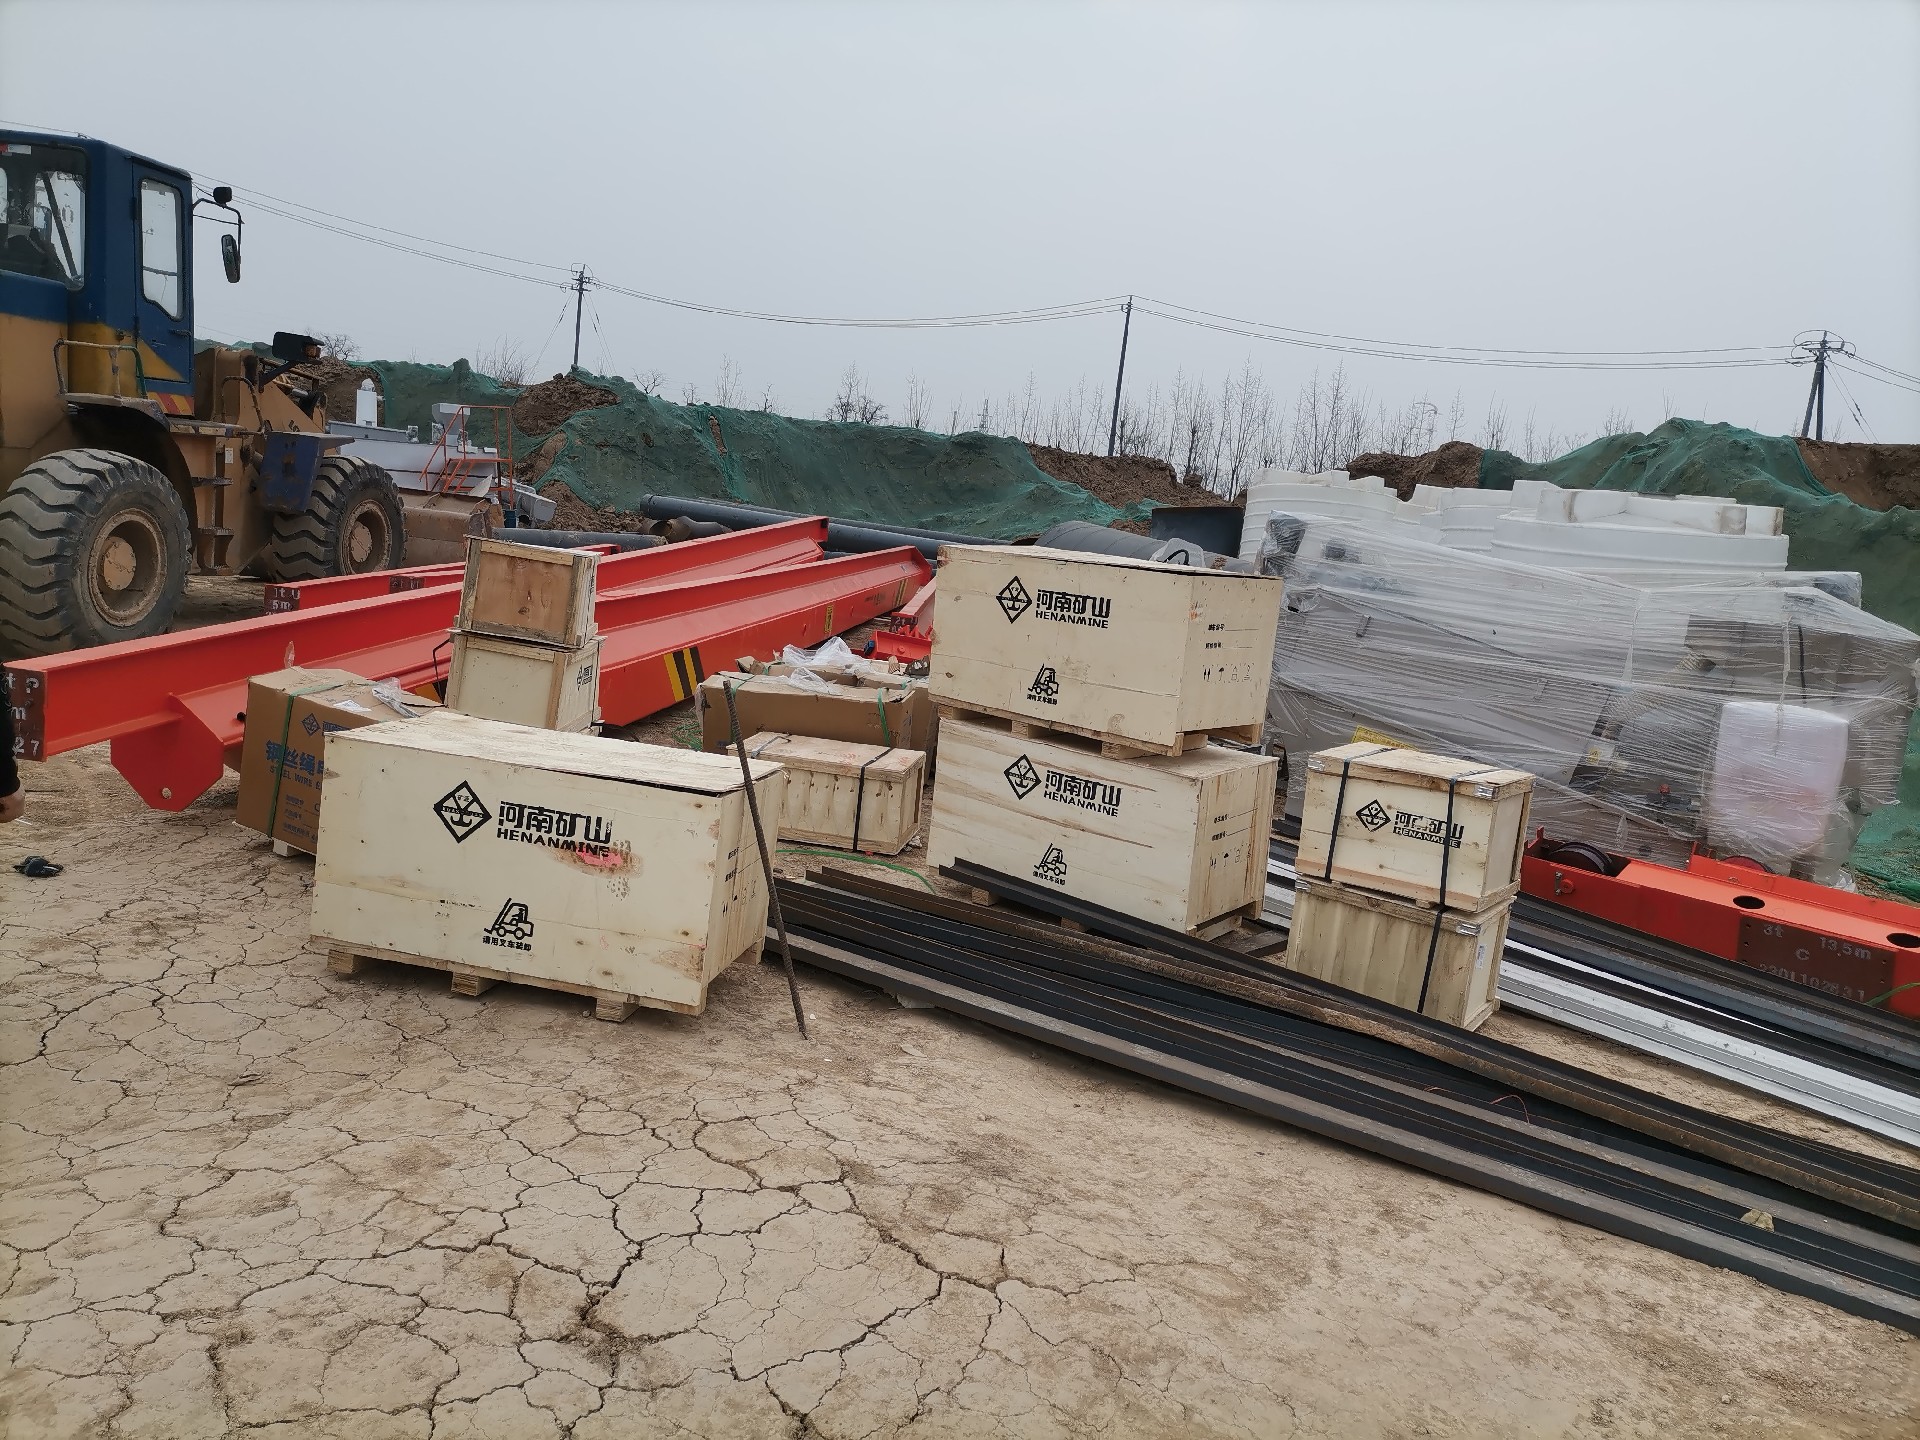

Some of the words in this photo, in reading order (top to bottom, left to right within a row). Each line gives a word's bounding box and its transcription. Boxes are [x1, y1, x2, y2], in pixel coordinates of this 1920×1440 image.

[1037, 589, 1111, 618] 河南矿山
[1035, 610, 1109, 629] HENANMINE
[1045, 769, 1122, 808] 河南矿山
[1043, 790, 1119, 817] HENANMINE
[499, 800, 613, 844] 河南矿山
[496, 827, 611, 858] HENANMINE
[482, 935, 532, 952] 请用叉车装卸
